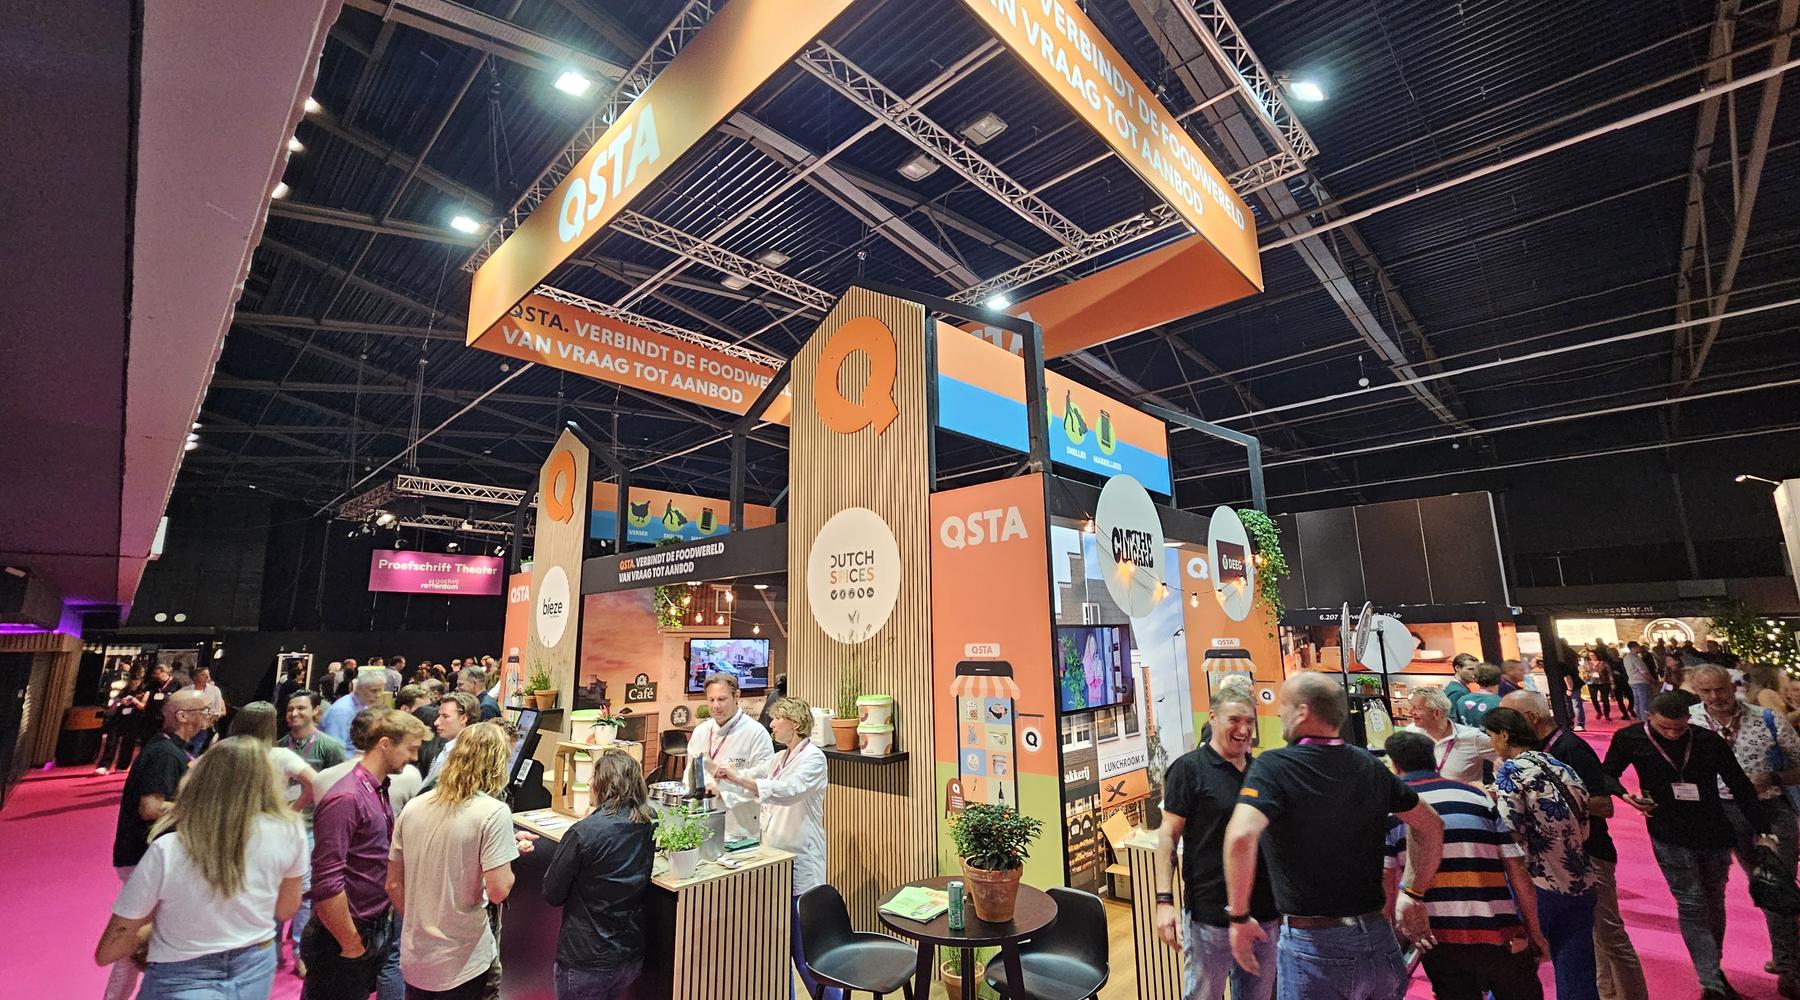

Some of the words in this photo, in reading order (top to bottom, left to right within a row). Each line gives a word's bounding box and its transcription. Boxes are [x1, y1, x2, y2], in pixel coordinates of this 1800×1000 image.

[1021, 7, 1100, 110] VRAAG
[1104, 95, 1138, 149] TOT
[1141, 138, 1204, 216] AANBOD
[1041, 0, 1135, 108] VERBINDT
[1138, 95, 1159, 136] DE
[1162, 121, 1245, 231] FOODWERELD
[558, 102, 661, 244] QSTA
[574, 319, 670, 362] VERBINDT
[673, 350, 696, 369] DE
[502, 325, 552, 354] VAN
[557, 340, 630, 374] VRAAG
[634, 361, 668, 385] TOT
[670, 374, 743, 403] AANBOD
[815, 316, 899, 436] Q
[546, 449, 576, 525] Q
[941, 505, 1029, 550] QSTA
[619, 559, 635, 571] QSTA.
[636, 553, 665, 567] VERBINDT
[666, 551, 675, 562] DE
[676, 542, 724, 561] FOODWERELD
[830, 550, 874, 568] DUTCH
[1228, 558, 1243, 571] DEEG
[378, 559, 452, 573] Proefschrift
[455, 563, 498, 575] Theater
[618, 572, 631, 583] VAN
[632, 569, 652, 581] VRAAG
[653, 566, 665, 578] TOT
[665, 562, 694, 577] AANBOD
[830, 567, 875, 585] SPICES
[511, 585, 530, 604] QSTA
[971, 645, 993, 655] QSTA
[628, 688, 654, 701] Café
[1025, 731, 1038, 747] Q
[1104, 755, 1140, 773] LUNCHROOM
[1064, 765, 1089, 784] akkerij
